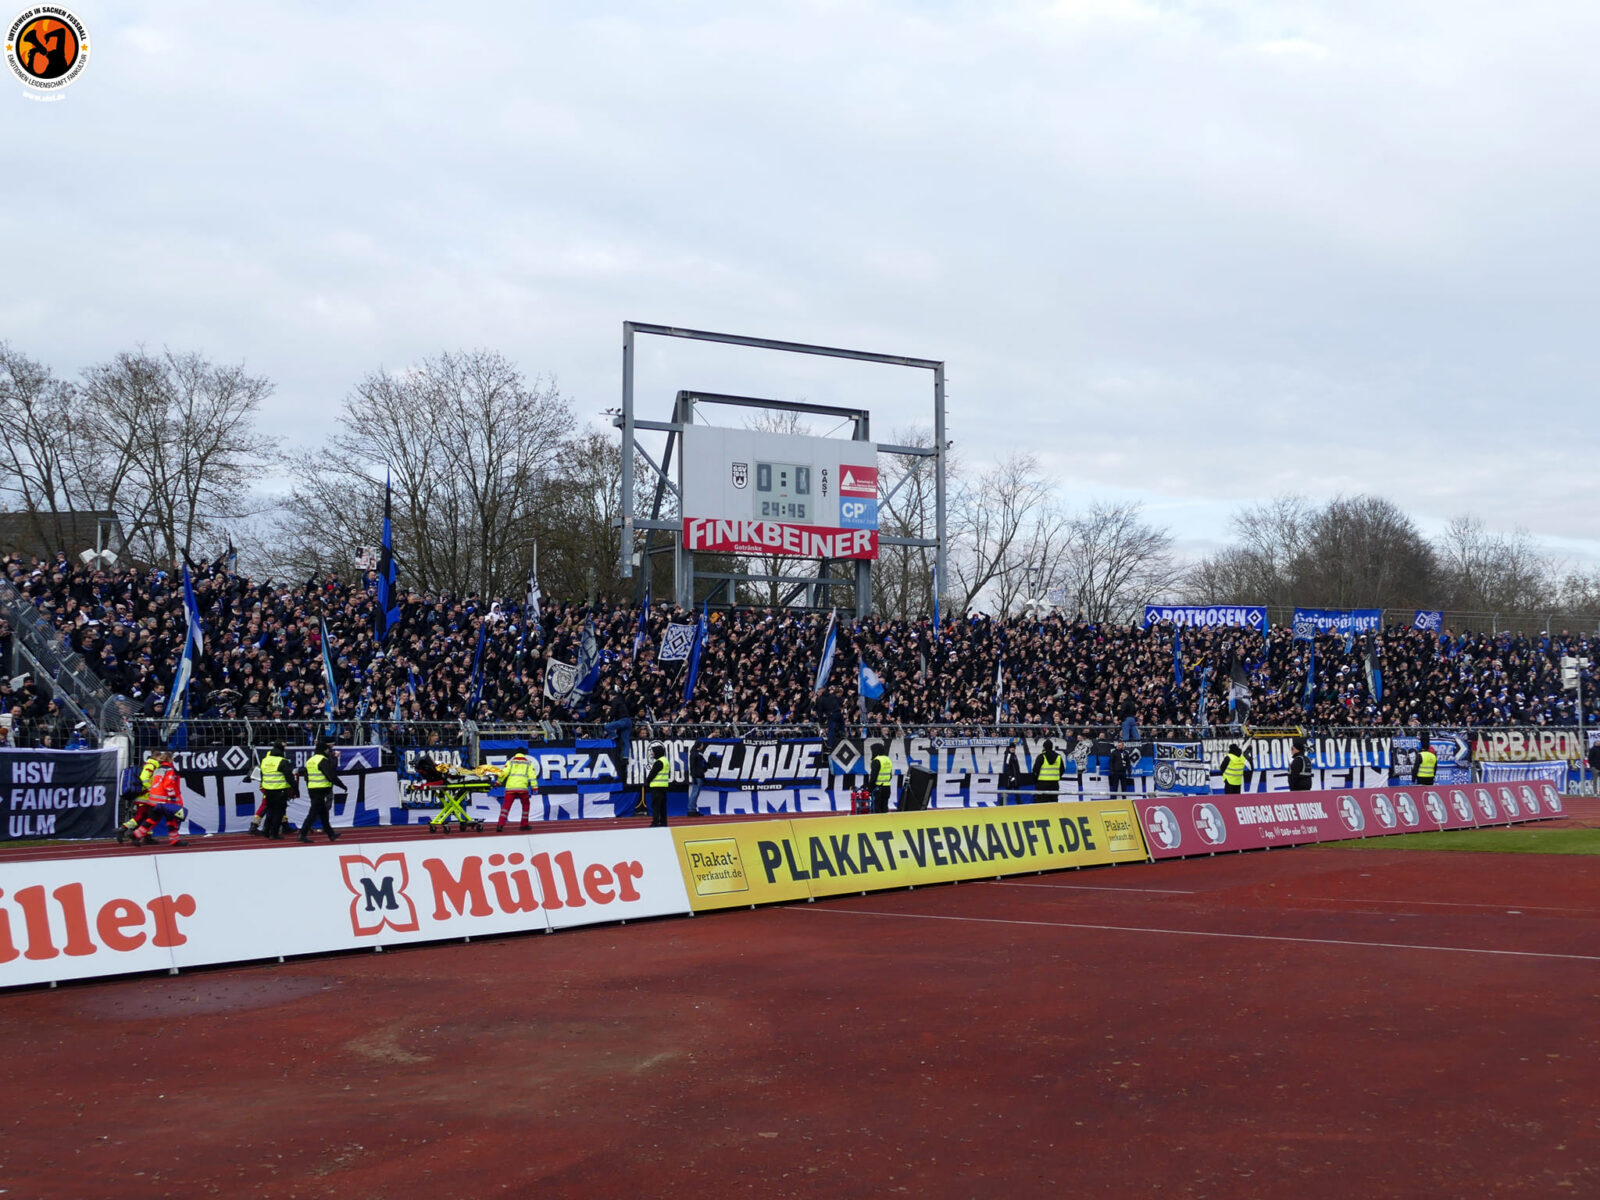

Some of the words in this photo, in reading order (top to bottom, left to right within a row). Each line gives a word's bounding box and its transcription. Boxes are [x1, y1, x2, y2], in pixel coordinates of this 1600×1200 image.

[734, 543, 763, 552] Getränke
[1316, 738, 1391, 768] LOYALTY
[12, 762, 55, 783] HSV
[10, 785, 106, 811] FANCLUB
[1235, 805, 1276, 825] EINFACH
[1274, 803, 1298, 822] GUTE
[1296, 802, 1328, 820] MUSIK.
[9, 814, 56, 837] ULM
[1104, 819, 1131, 832] Plakat-
[691, 851, 738, 869] Plakat-
[757, 816, 1096, 884] PLAKAT-VERKAUFT.DE
[422, 850, 644, 921] Müller
[697, 868, 742, 882] verkauft.de
[360, 876, 399, 912] M
